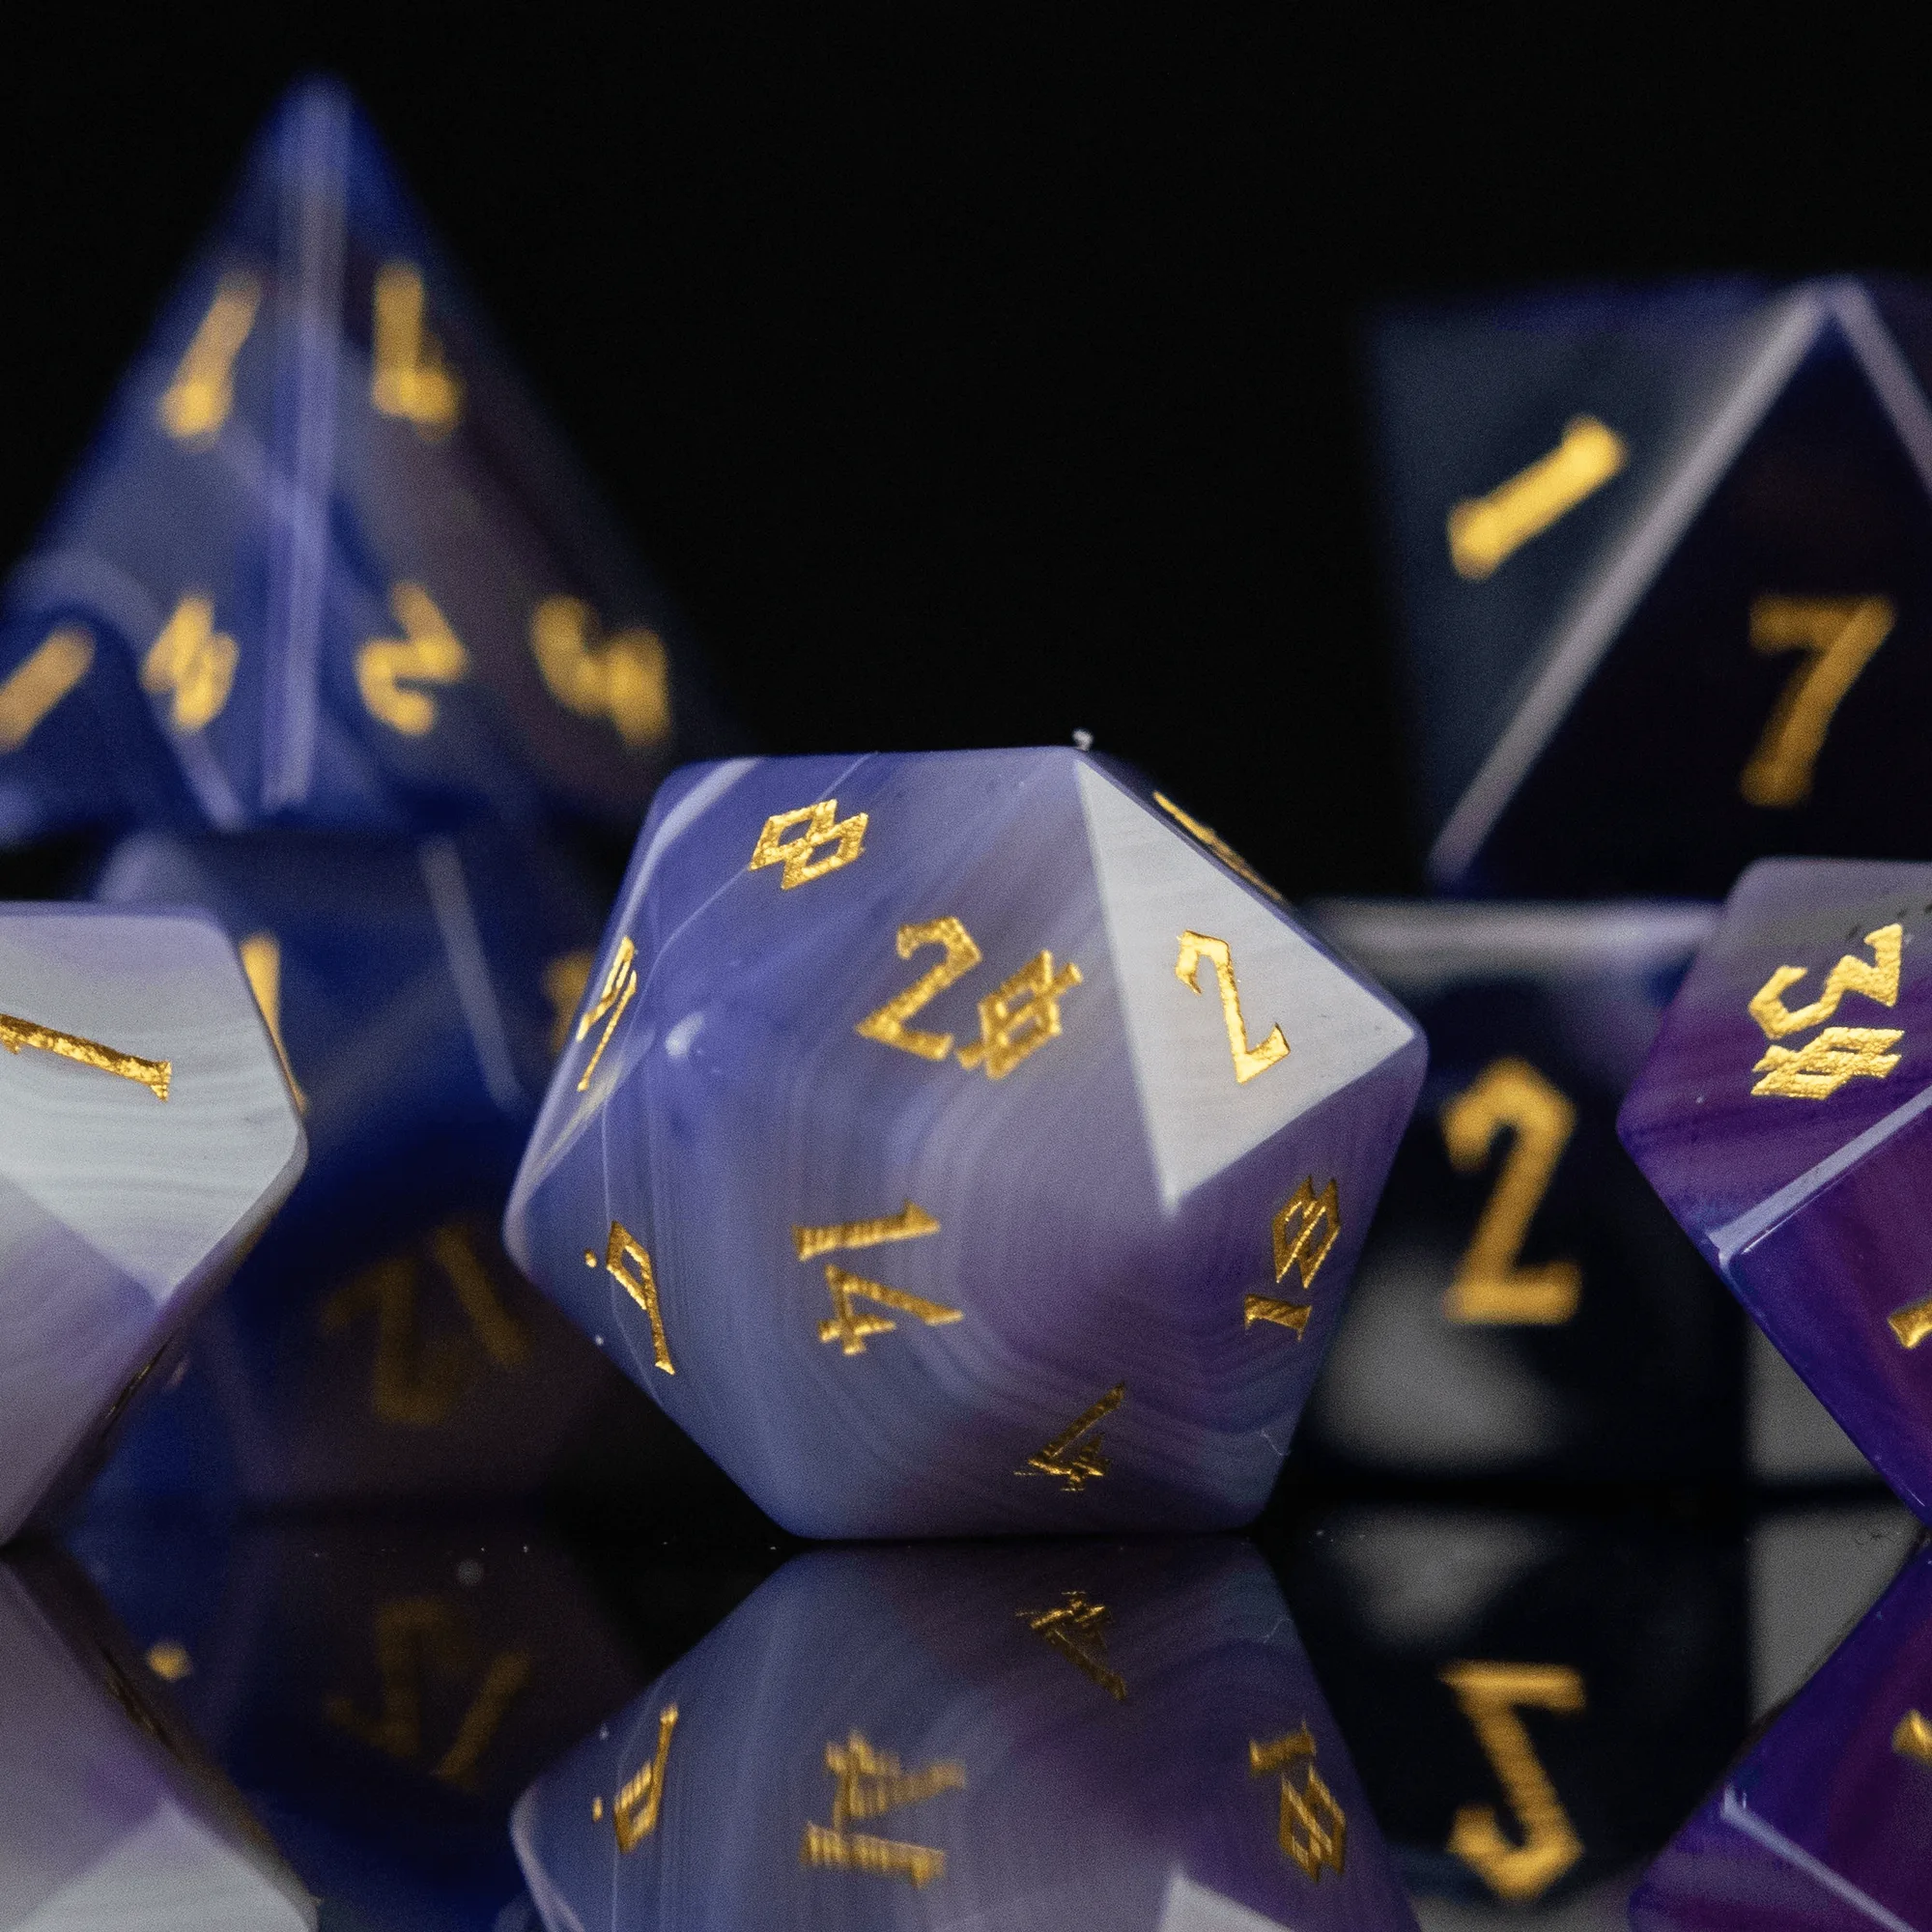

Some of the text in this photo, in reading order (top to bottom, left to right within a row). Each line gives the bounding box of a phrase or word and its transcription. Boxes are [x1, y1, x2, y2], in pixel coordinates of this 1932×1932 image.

[1448, 415, 1627, 580] 1
[1742, 594, 1893, 807] 7
[751, 799, 868, 890] 8
[1176, 929, 1291, 1085] 2
[1441, 1056, 1581, 1324] 2
[791, 1199, 963, 1356] 14
